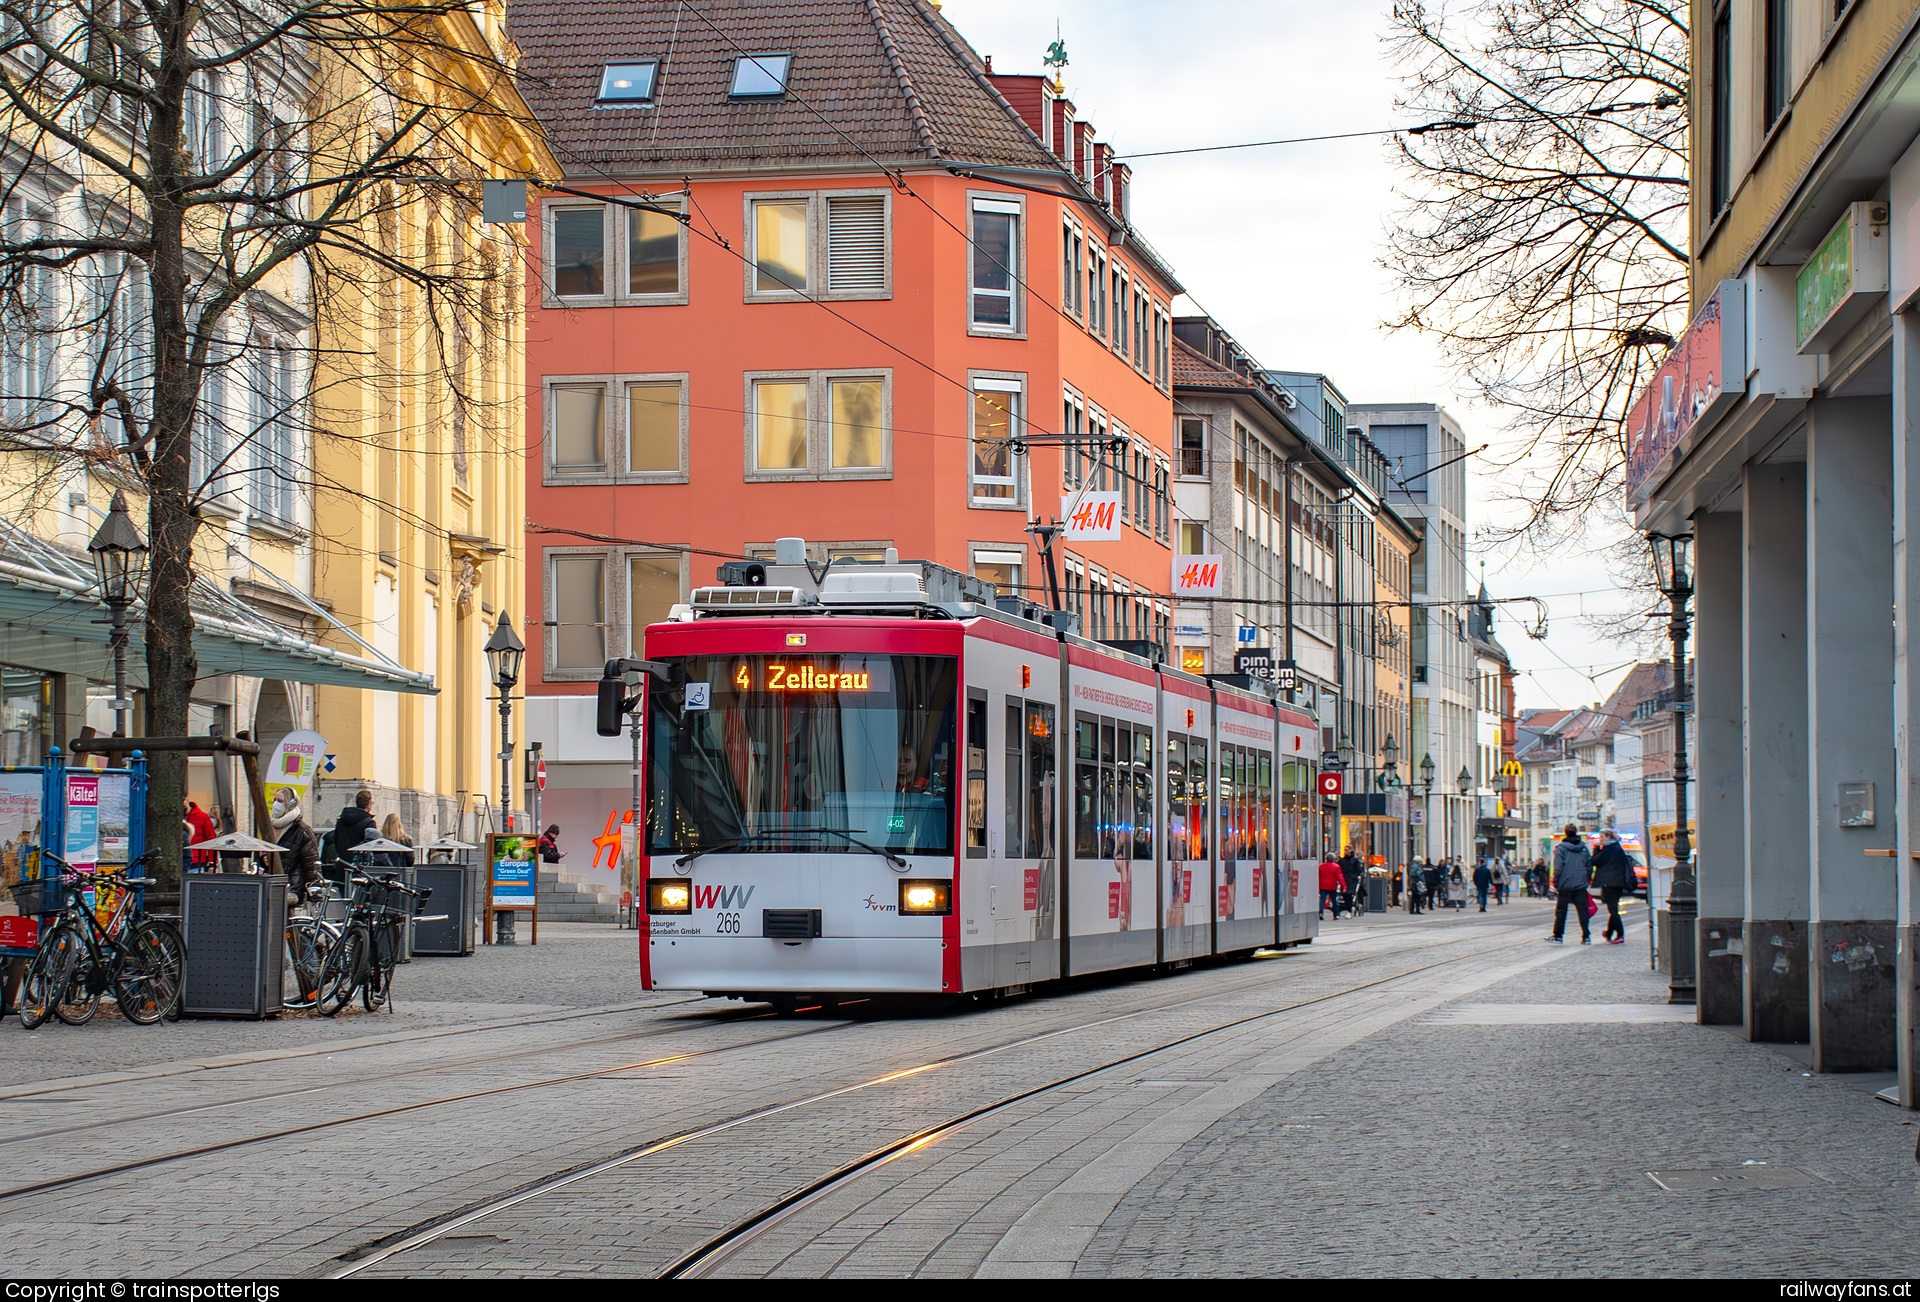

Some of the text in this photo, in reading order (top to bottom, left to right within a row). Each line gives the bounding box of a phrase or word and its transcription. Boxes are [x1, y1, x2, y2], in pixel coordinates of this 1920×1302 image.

[1072, 501, 1116, 531] H&M
[1180, 563, 1218, 588] H&M
[1240, 656, 1268, 670] pim
[736, 665, 868, 689] 4 Zellerau
[1245, 667, 1268, 677] kie
[1324, 757, 1341, 765] ONL
[70, 786, 97, 802] Kälte!
[888, 819, 904, 828] 4-02
[694, 885, 755, 909] WVV
[871, 903, 896, 911] vvm
[716, 912, 741, 933] 266
